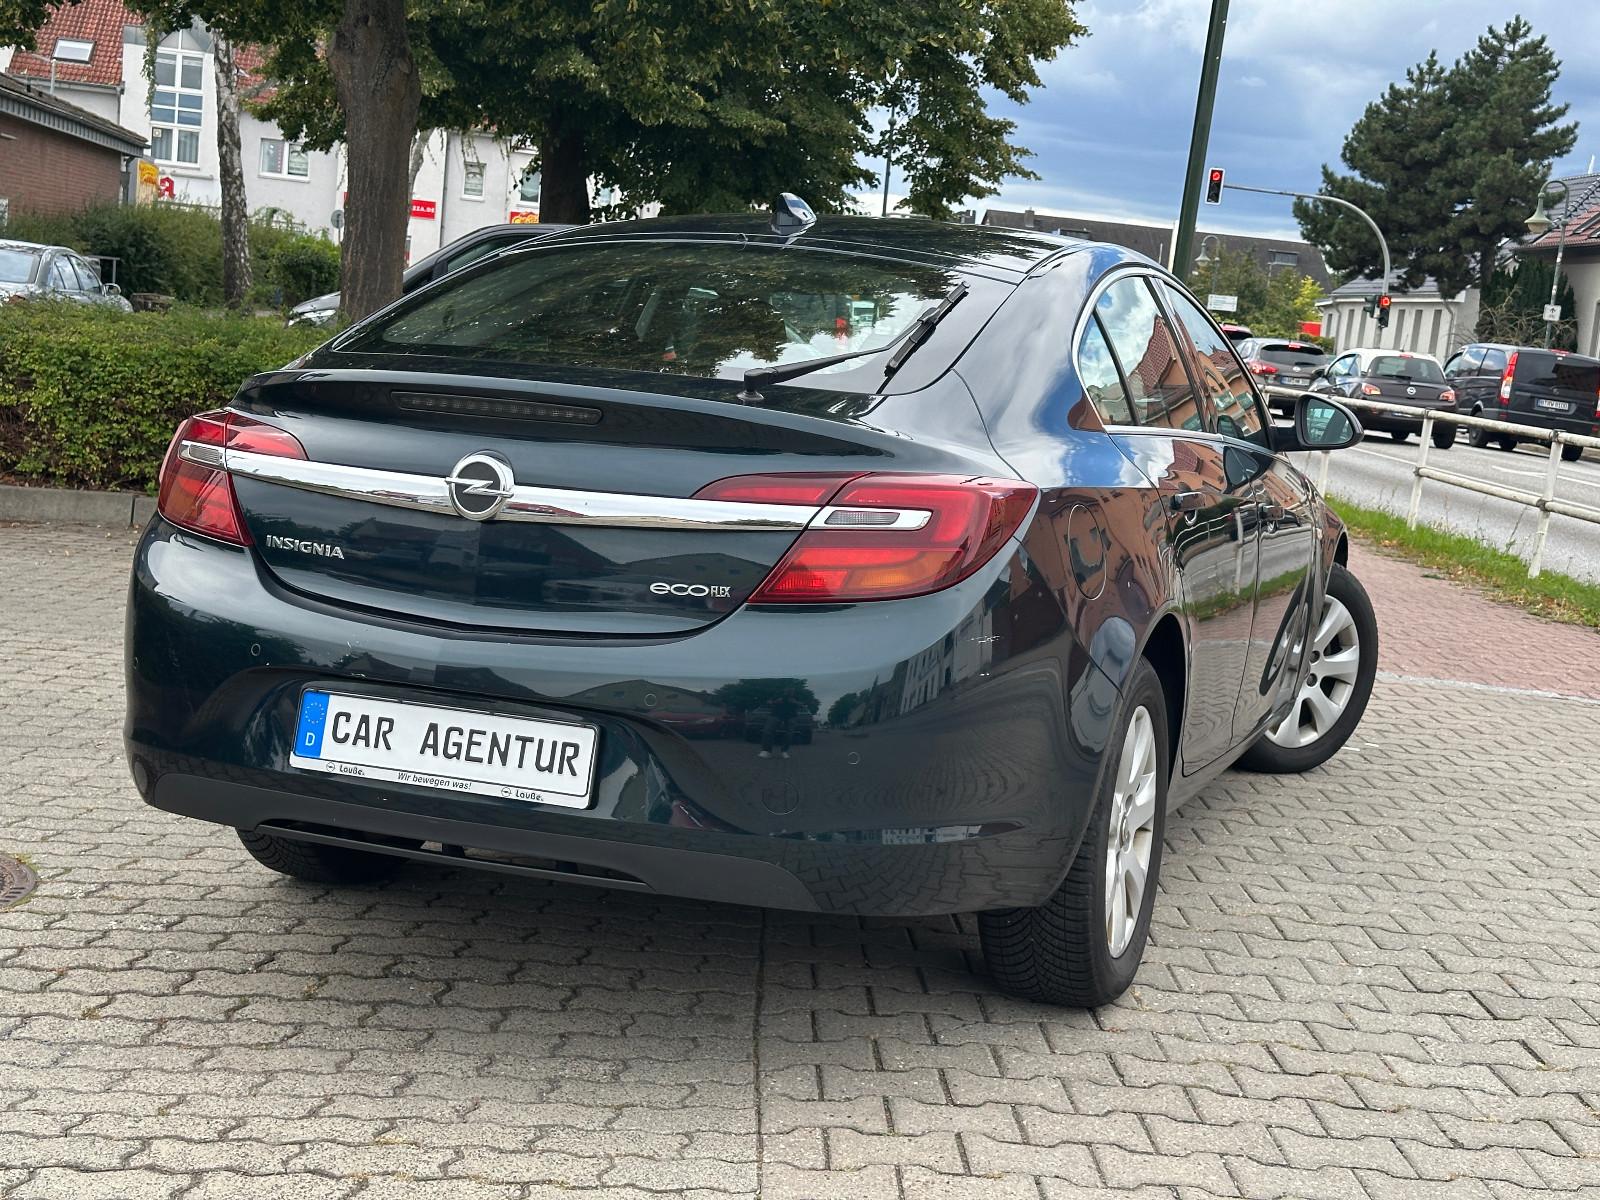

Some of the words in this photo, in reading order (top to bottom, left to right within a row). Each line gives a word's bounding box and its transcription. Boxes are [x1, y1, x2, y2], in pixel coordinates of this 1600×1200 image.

[265, 534, 345, 560] INSIGNIA
[304, 732, 316, 747] D
[331, 711, 395, 750] CAR
[419, 722, 580, 777] AGENTUR
[397, 772, 411, 782] Wir
[412, 773, 450, 787] bewegen
[452, 781, 472, 791] was!
